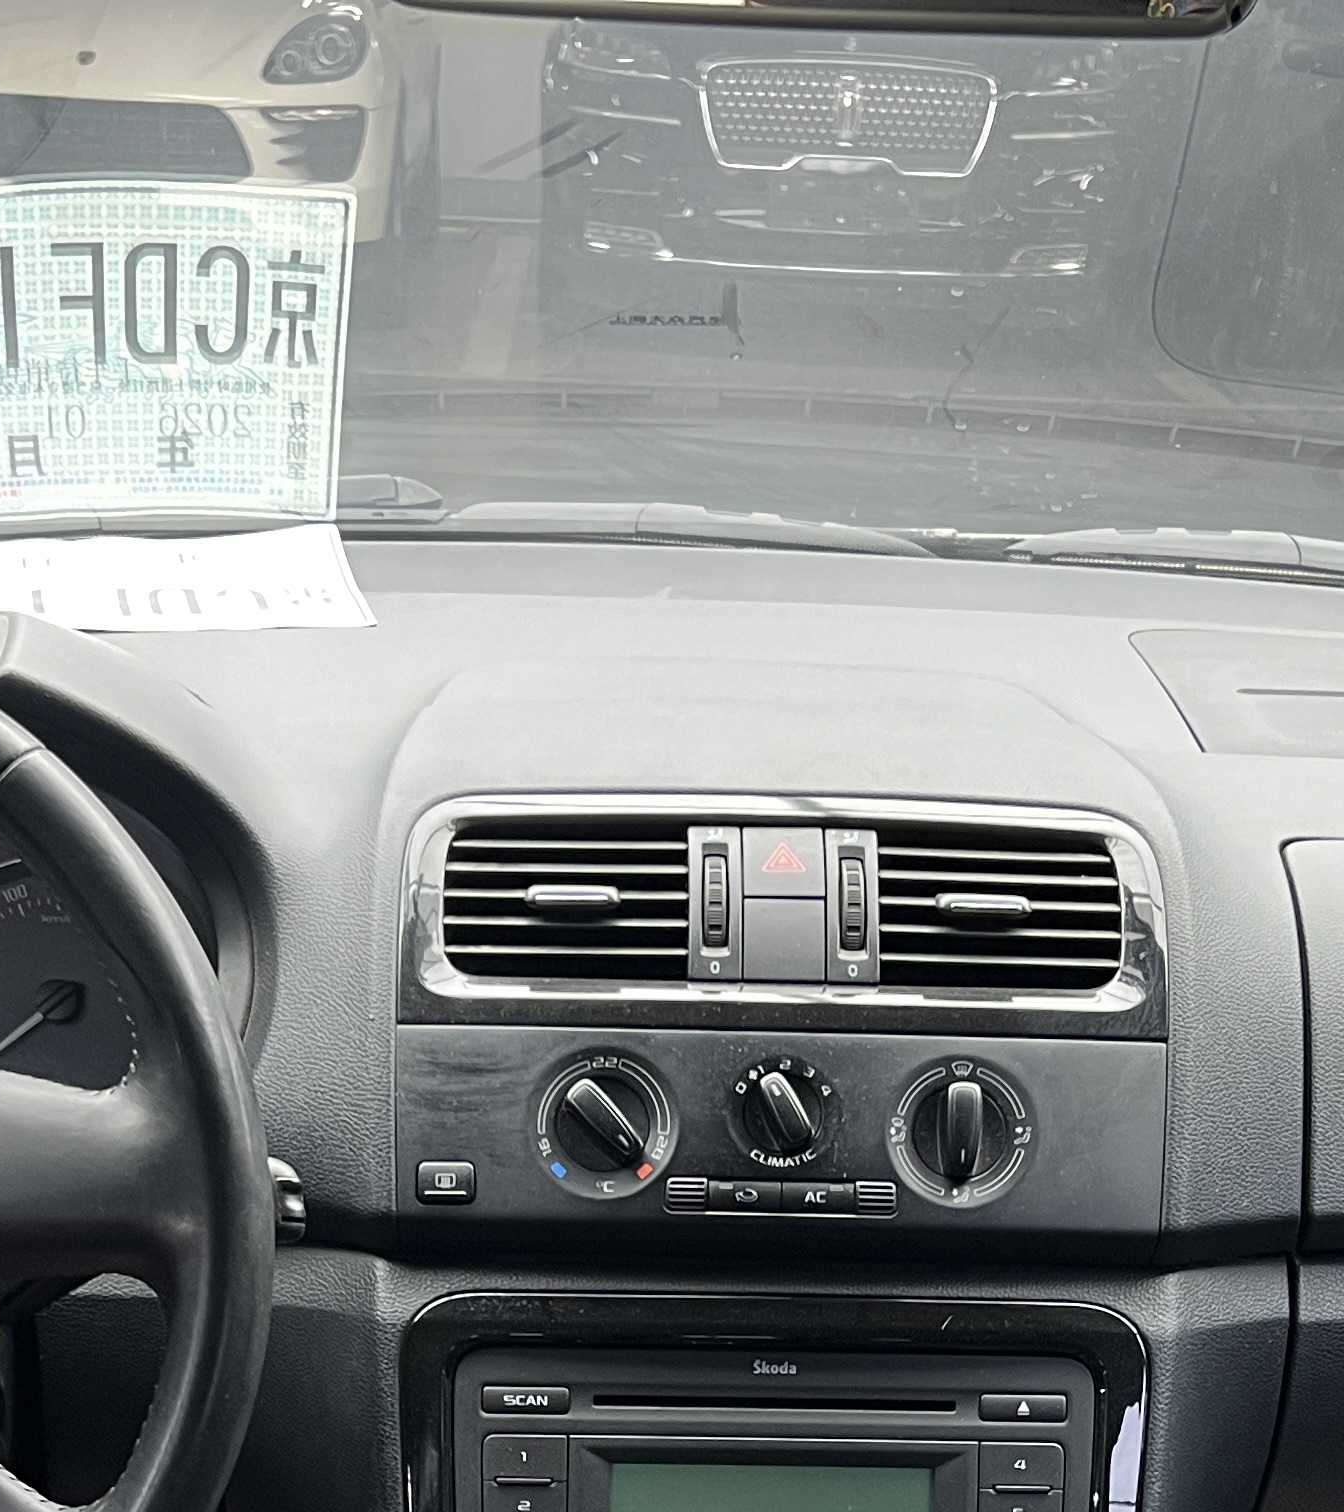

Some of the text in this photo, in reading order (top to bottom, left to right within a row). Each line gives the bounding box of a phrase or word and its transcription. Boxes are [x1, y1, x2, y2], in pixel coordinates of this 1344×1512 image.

[2, 884, 29, 903] 100
[592, 1056, 618, 1068] 22
[750, 1149, 817, 1168] CLIMATIC
[804, 1191, 827, 1204] AC
[502, 1393, 549, 1408] SCAN
[520, 1451, 527, 1463] 1
[1013, 1459, 1027, 1471] 4
[517, 1500, 531, 1512] 2
